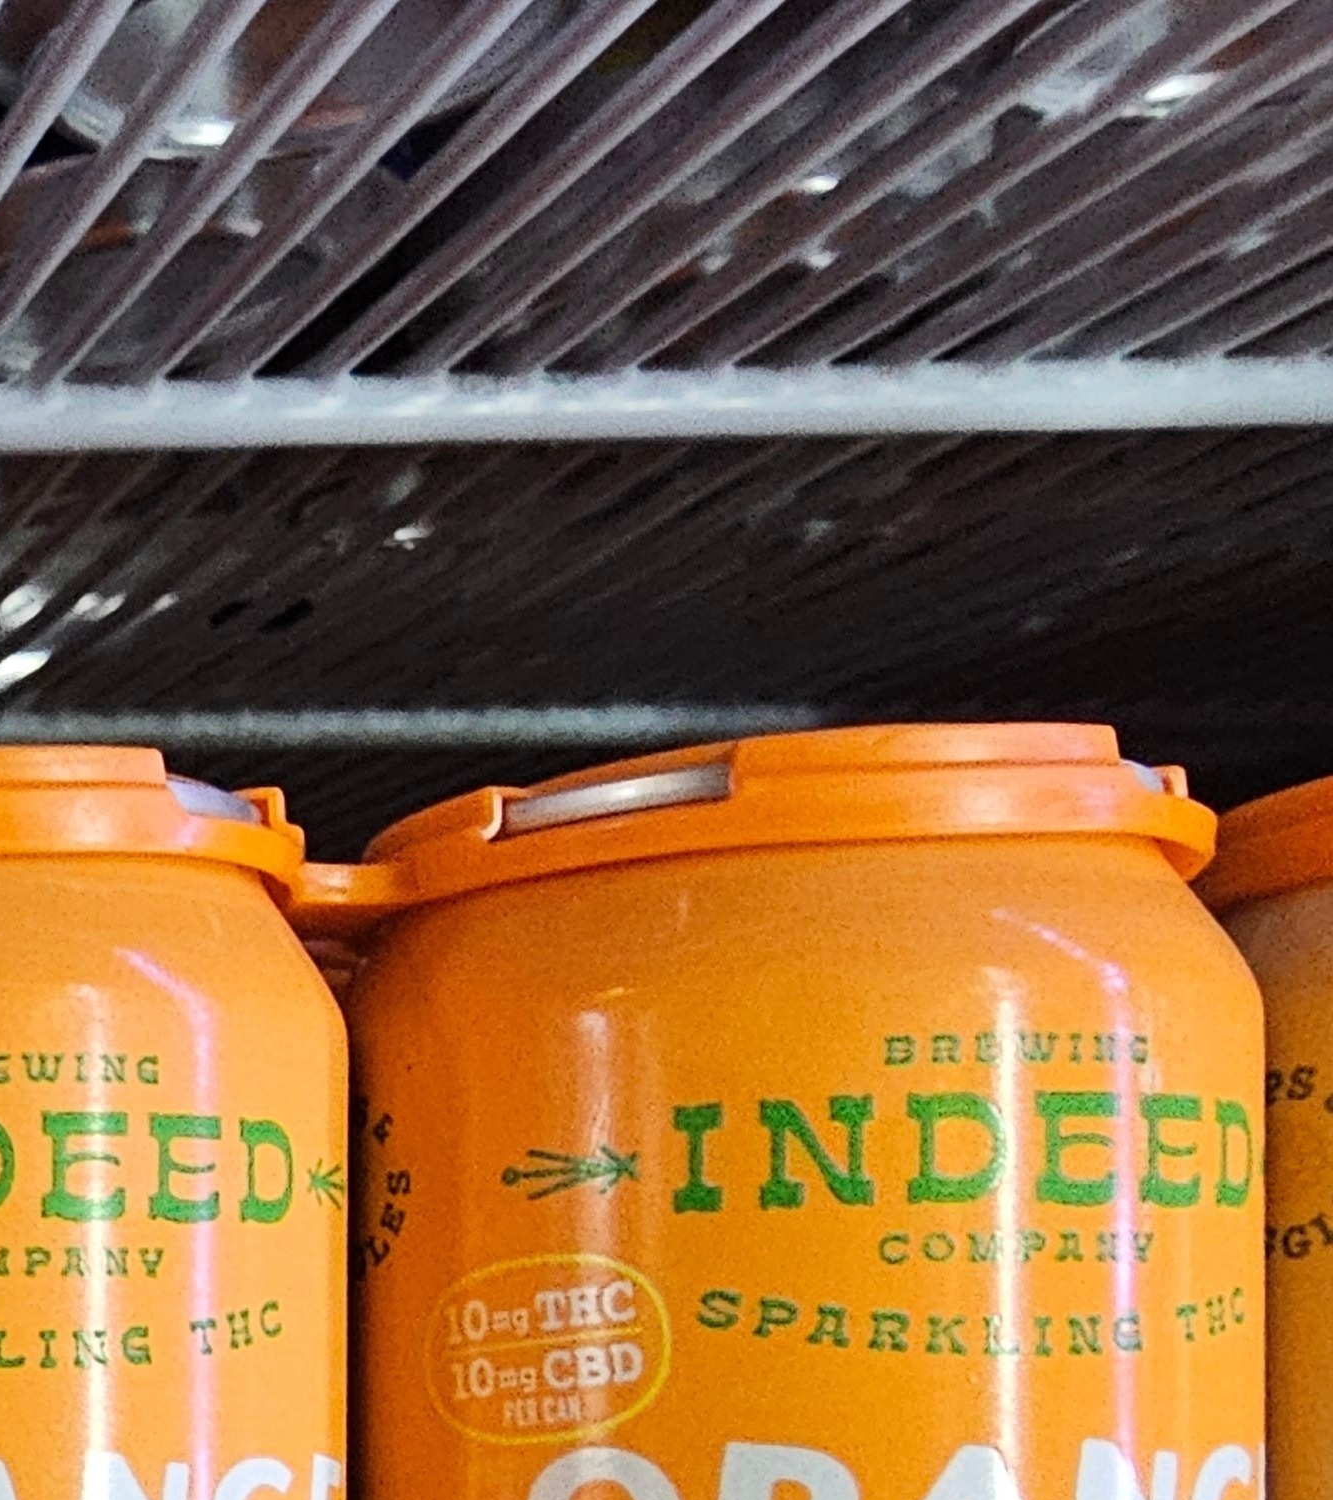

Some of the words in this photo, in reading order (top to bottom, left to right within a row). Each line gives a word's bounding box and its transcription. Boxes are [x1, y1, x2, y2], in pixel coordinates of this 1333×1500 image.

[883, 1030, 1151, 1069] BREWING
[671, 1091, 1253, 1216] INDEED
[877, 1230, 1155, 1268] COMPANY
[190, 1300, 283, 1357] THC
[535, 1280, 637, 1332] THC
[696, 1288, 1146, 1359] SPARKLING
[1175, 1285, 1247, 1345] THC
[541, 1342, 645, 1390] CBD
